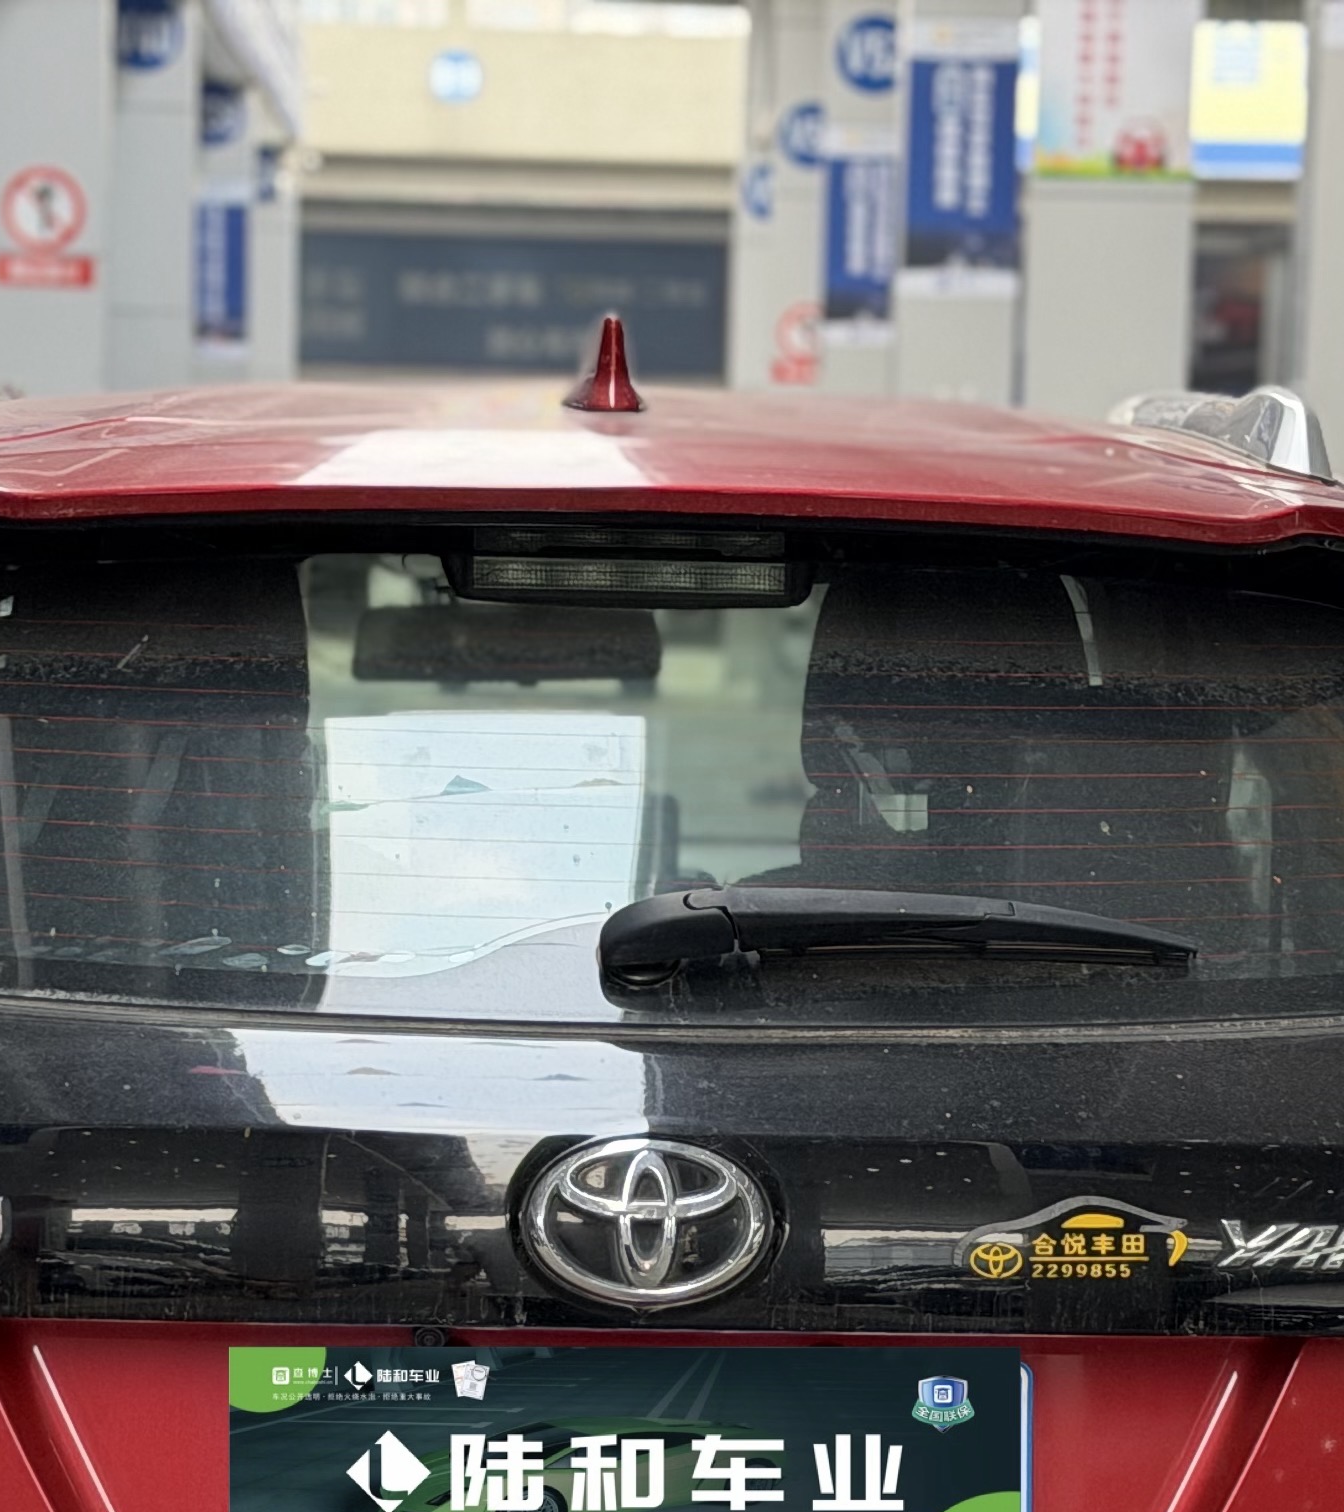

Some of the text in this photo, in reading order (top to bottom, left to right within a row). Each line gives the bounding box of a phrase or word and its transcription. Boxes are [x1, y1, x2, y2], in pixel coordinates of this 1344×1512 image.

[1031, 1233, 1145, 1255] 合悦丰田
[1032, 1264, 1132, 1278] 2299855
